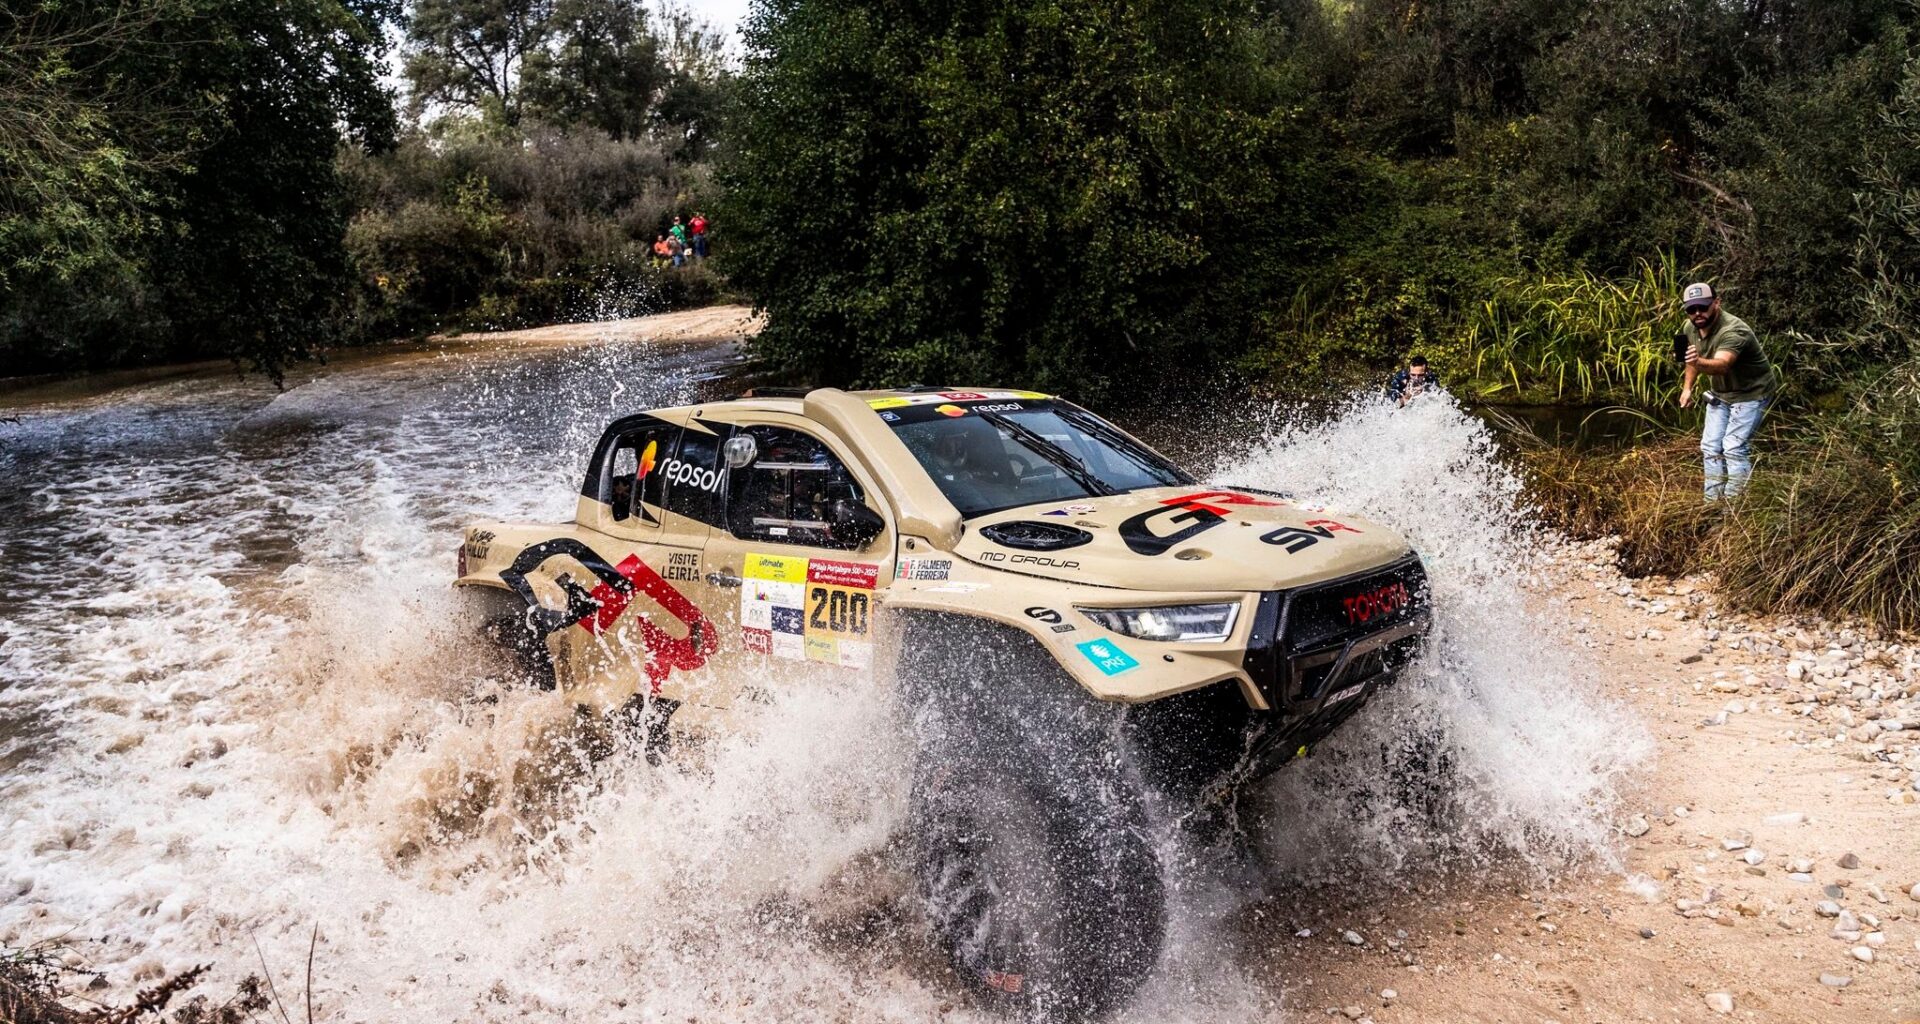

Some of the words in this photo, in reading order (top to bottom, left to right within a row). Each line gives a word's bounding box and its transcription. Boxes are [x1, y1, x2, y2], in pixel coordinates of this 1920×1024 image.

[972, 402, 1024, 413] repsol
[658, 457, 725, 493] repsol
[1118, 491, 1289, 557] GR
[669, 553, 697, 566] VISITE
[918, 559, 952, 570] PALMEIRO
[980, 551, 1006, 562] MD
[661, 566, 700, 582] LEIRIA
[915, 570, 949, 580] FERREIRA
[1343, 581, 1408, 624] TOYOTA
[810, 587, 868, 636] 200
[1102, 655, 1126, 671] PRF
